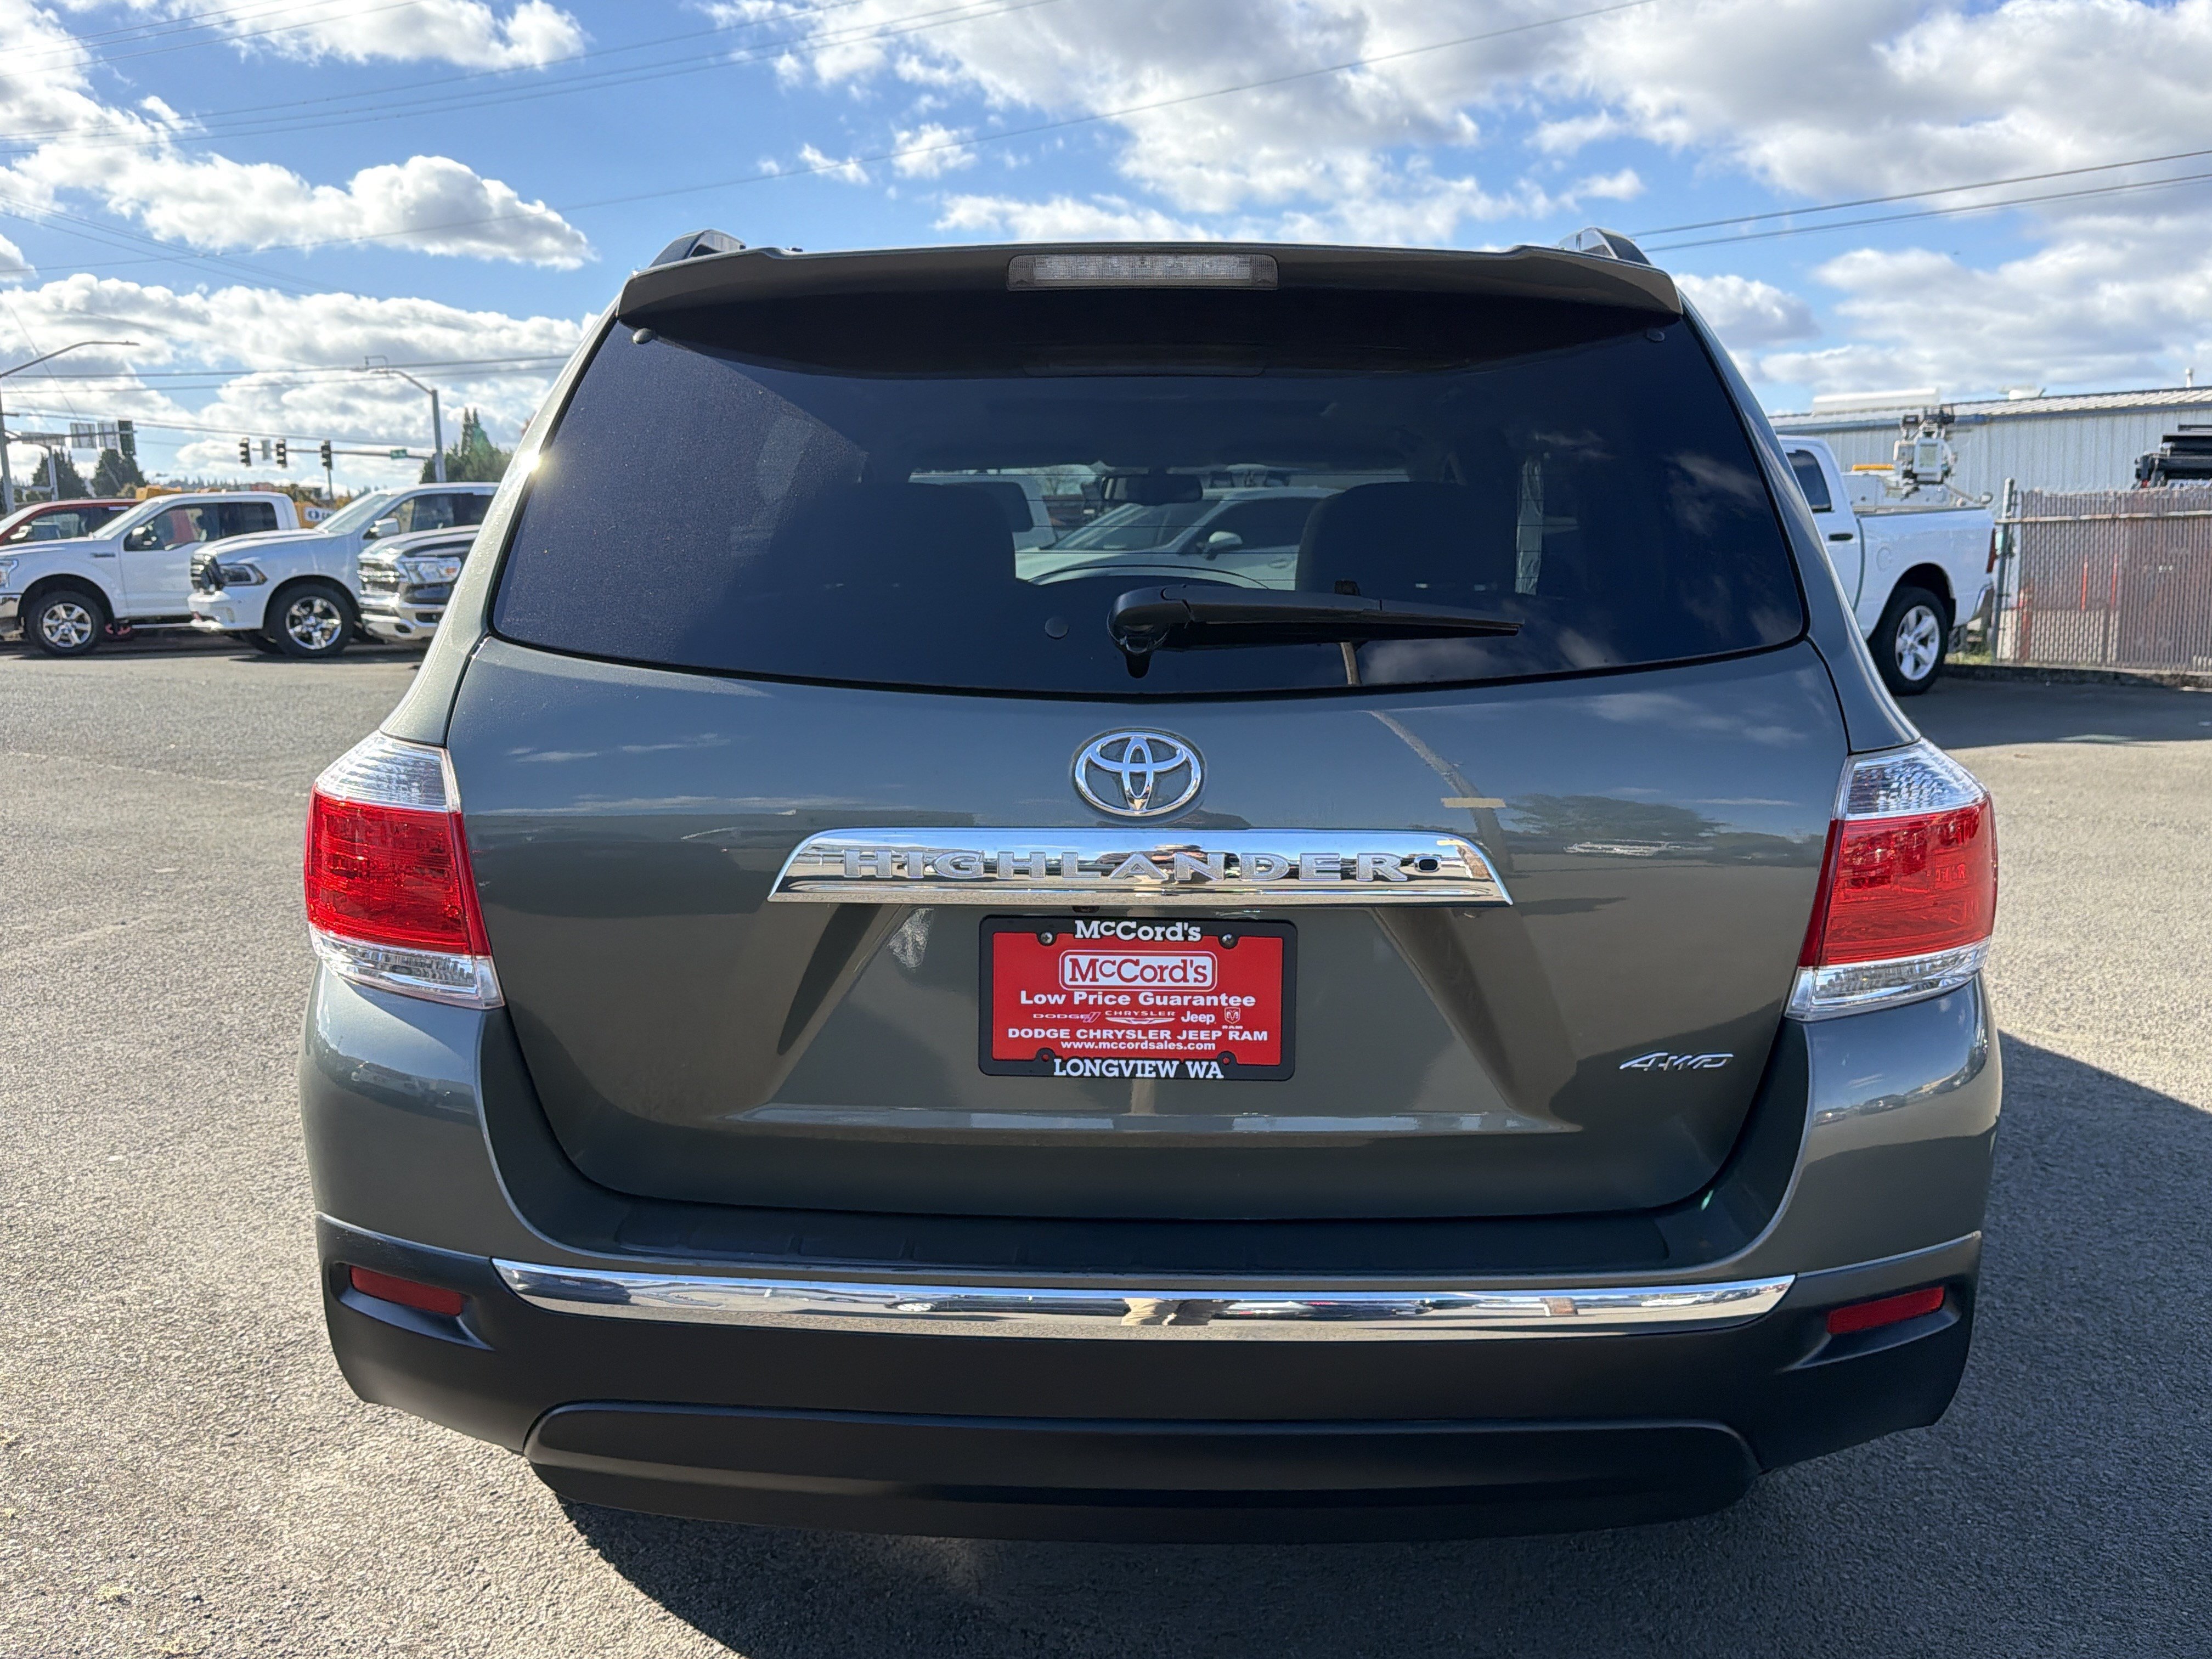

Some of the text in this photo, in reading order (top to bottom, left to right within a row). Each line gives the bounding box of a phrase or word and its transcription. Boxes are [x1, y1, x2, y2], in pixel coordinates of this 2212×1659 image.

[844, 849, 1408, 881] HIGHLANDER
[1074, 919, 1201, 941] McCord's
[1069, 957, 1207, 984] McCord's
[1020, 990, 1256, 1006] Low Price Guarantee
[1181, 1011, 1216, 1024] Jeep
[1008, 1028, 1268, 1041] DODGE CHRYSLER JEEP RAM
[1060, 1040, 1216, 1051] www.mccordsales.com
[1054, 1058, 1224, 1079] LONGVIEW WA
[1619, 1051, 1734, 1071] 4WD
